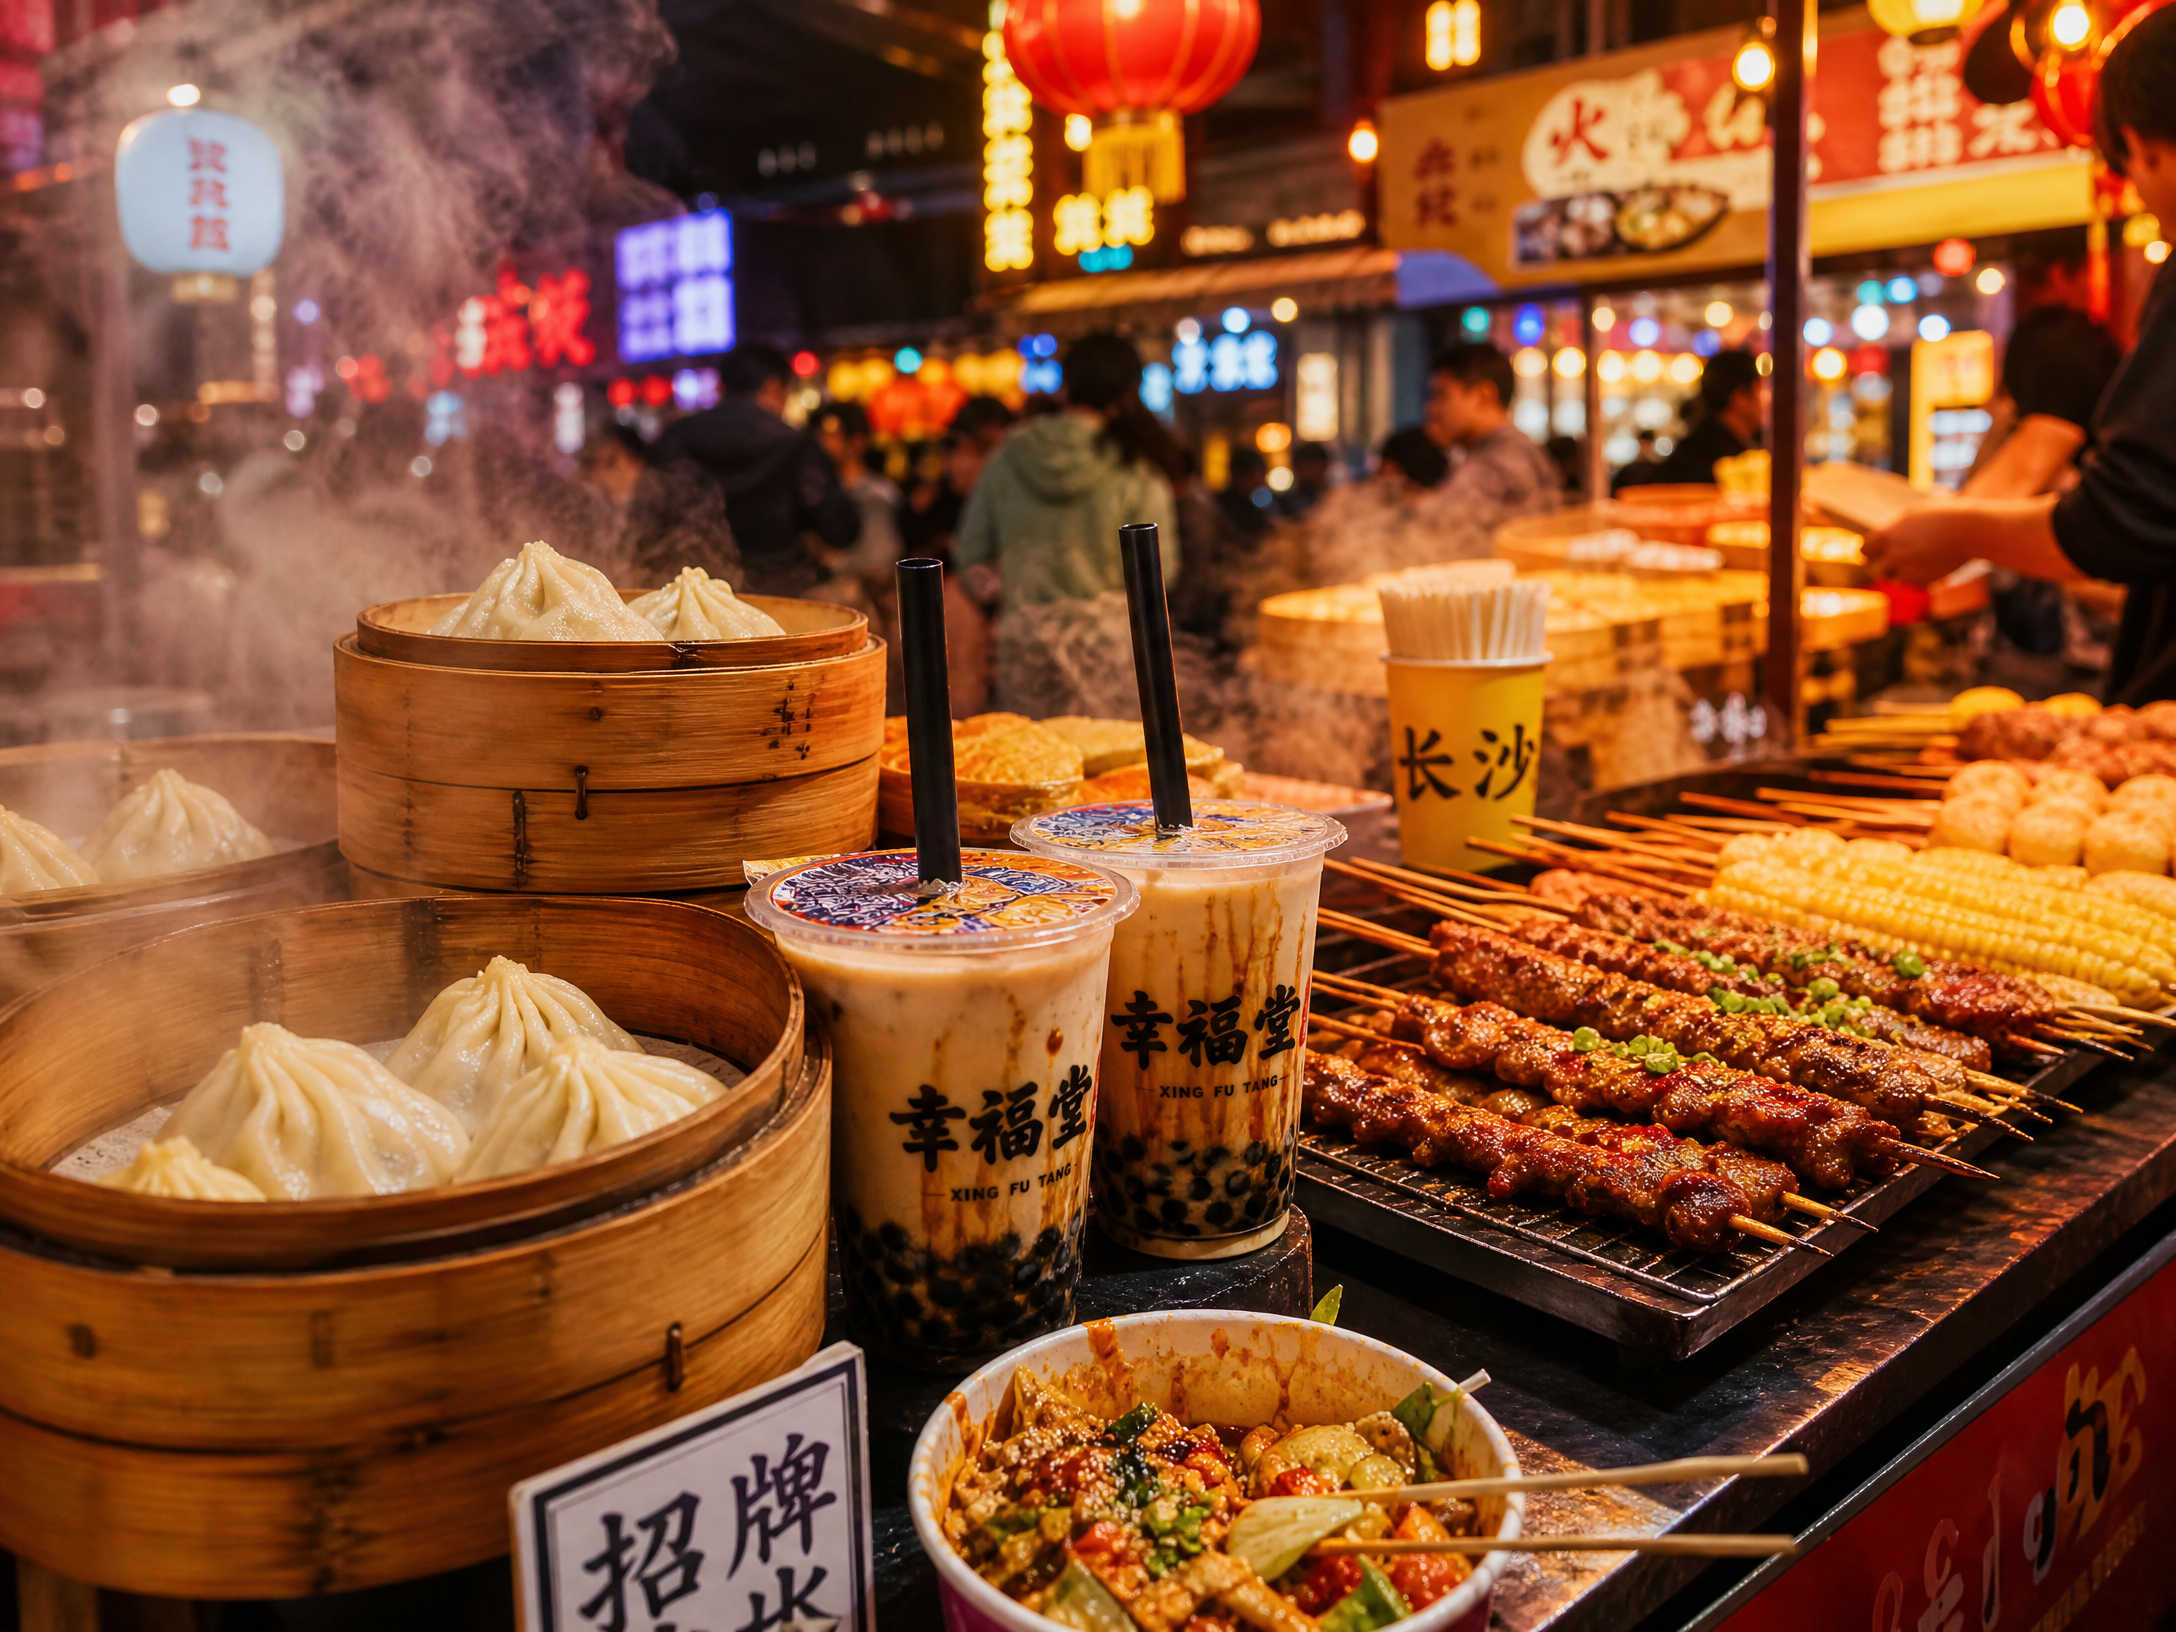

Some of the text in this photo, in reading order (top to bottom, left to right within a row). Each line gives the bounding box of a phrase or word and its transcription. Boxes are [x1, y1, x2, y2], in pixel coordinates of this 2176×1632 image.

[1398, 723, 1535, 801] 长沙
[1110, 984, 1301, 1071] 幸福堂
[889, 1065, 1093, 1173] 幸福堂
[1159, 1074, 1279, 1099] XING FU TANG
[950, 1162, 1072, 1202] XING FU TANG
[578, 1433, 837, 1632] 招牌
